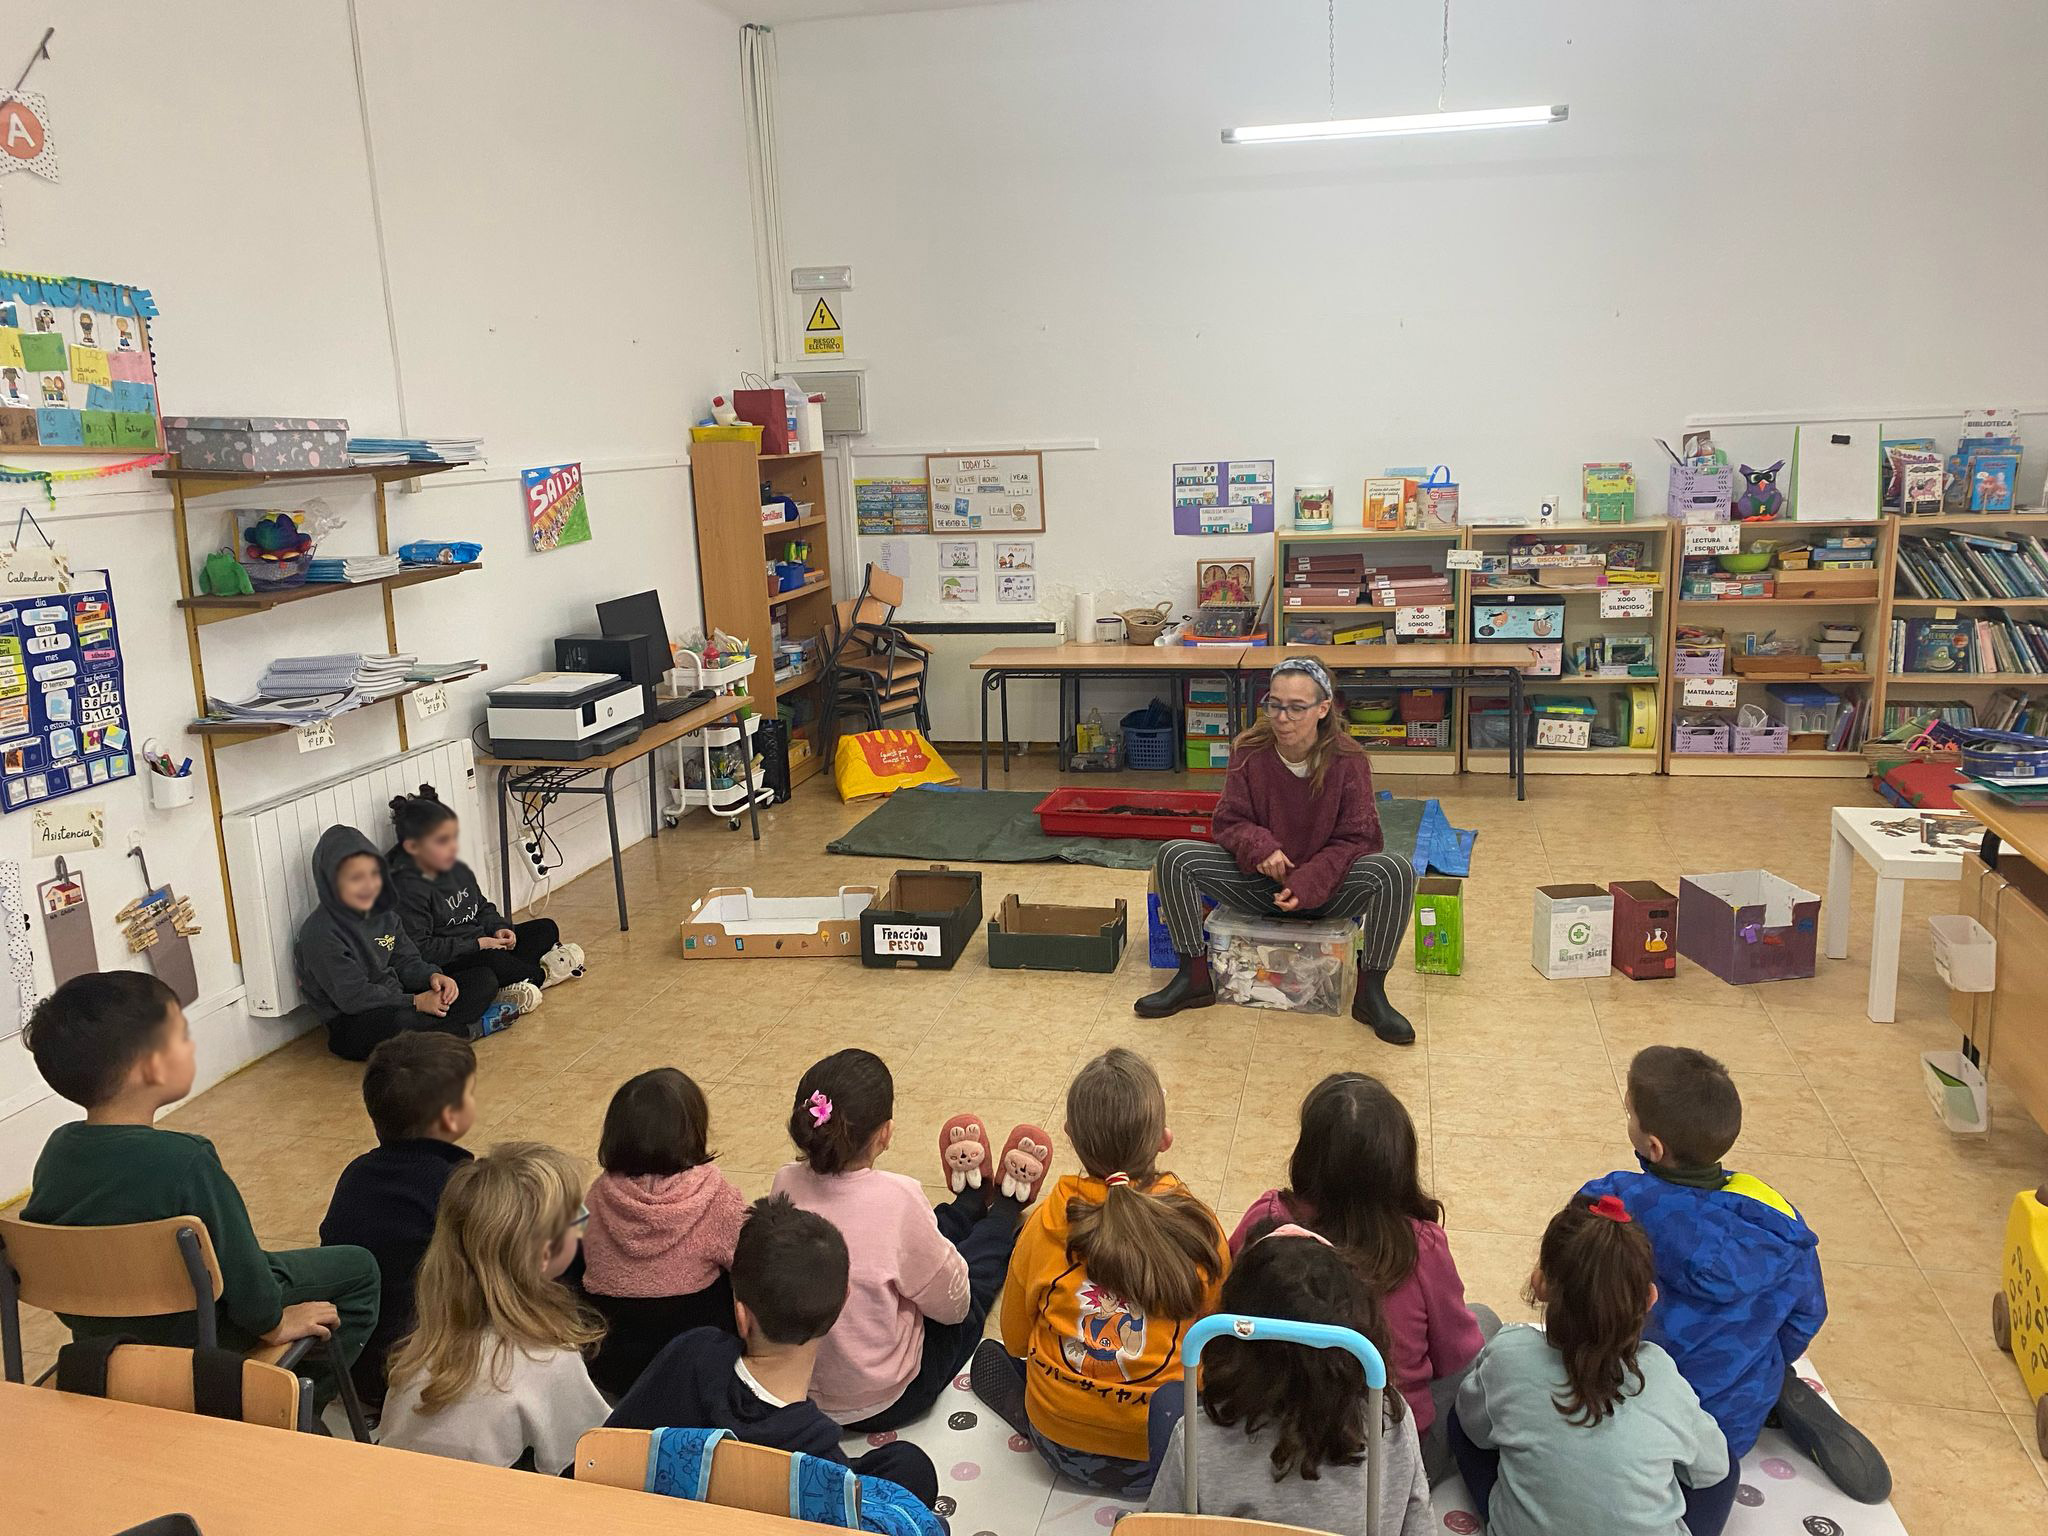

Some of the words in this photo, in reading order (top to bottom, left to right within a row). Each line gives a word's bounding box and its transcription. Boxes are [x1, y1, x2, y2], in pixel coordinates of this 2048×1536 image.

[7, 112, 36, 148] A
[1967, 420, 2013, 428] BIBLIOTECA
[962, 460, 980, 470] TODAY
[982, 476, 998, 484] MONTH
[935, 503, 950, 511] SEASON
[1537, 555, 1568, 563] DISCOVER
[7, 571, 55, 584] Calendario
[45, 653, 59, 662] mes
[49, 680, 68, 688] tempo
[92, 686, 97, 694] 2
[104, 683, 110, 691] 3
[84, 699, 90, 708] 5
[92, 698, 98, 707] 6
[103, 694, 109, 703] 7
[112, 693, 118, 702] 8
[84, 712, 91, 721] 9
[95, 711, 100, 720] 1
[105, 708, 112, 717] 2
[115, 706, 120, 715] 0
[42, 826, 93, 842] Asistencia
[1029, 1347, 1151, 1405] ーパーサイヤ人
